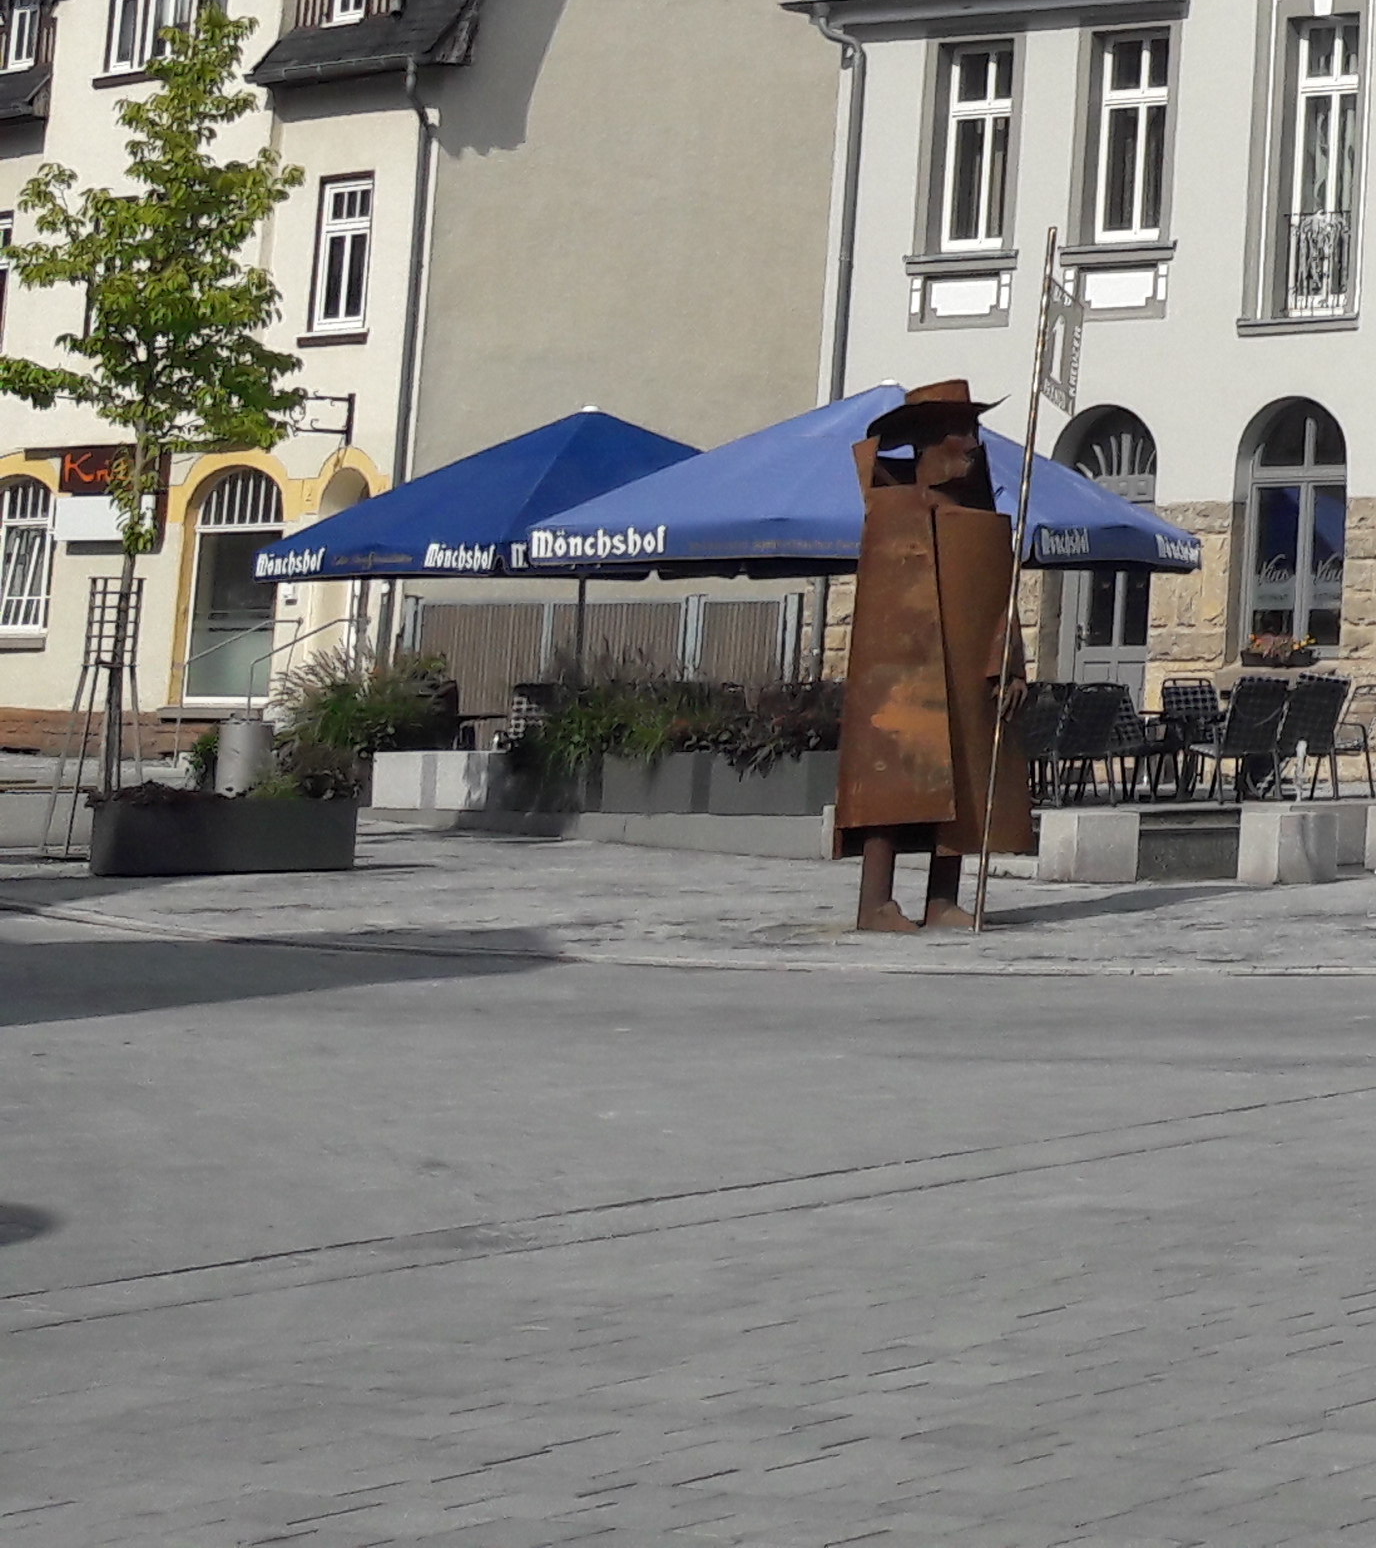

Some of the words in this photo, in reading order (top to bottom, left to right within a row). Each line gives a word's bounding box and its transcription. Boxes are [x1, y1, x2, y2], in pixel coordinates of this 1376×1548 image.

[423, 542, 497, 571] Mönchshof
[531, 525, 667, 559] Mönchshof
[255, 544, 326, 578] Mönchshof
